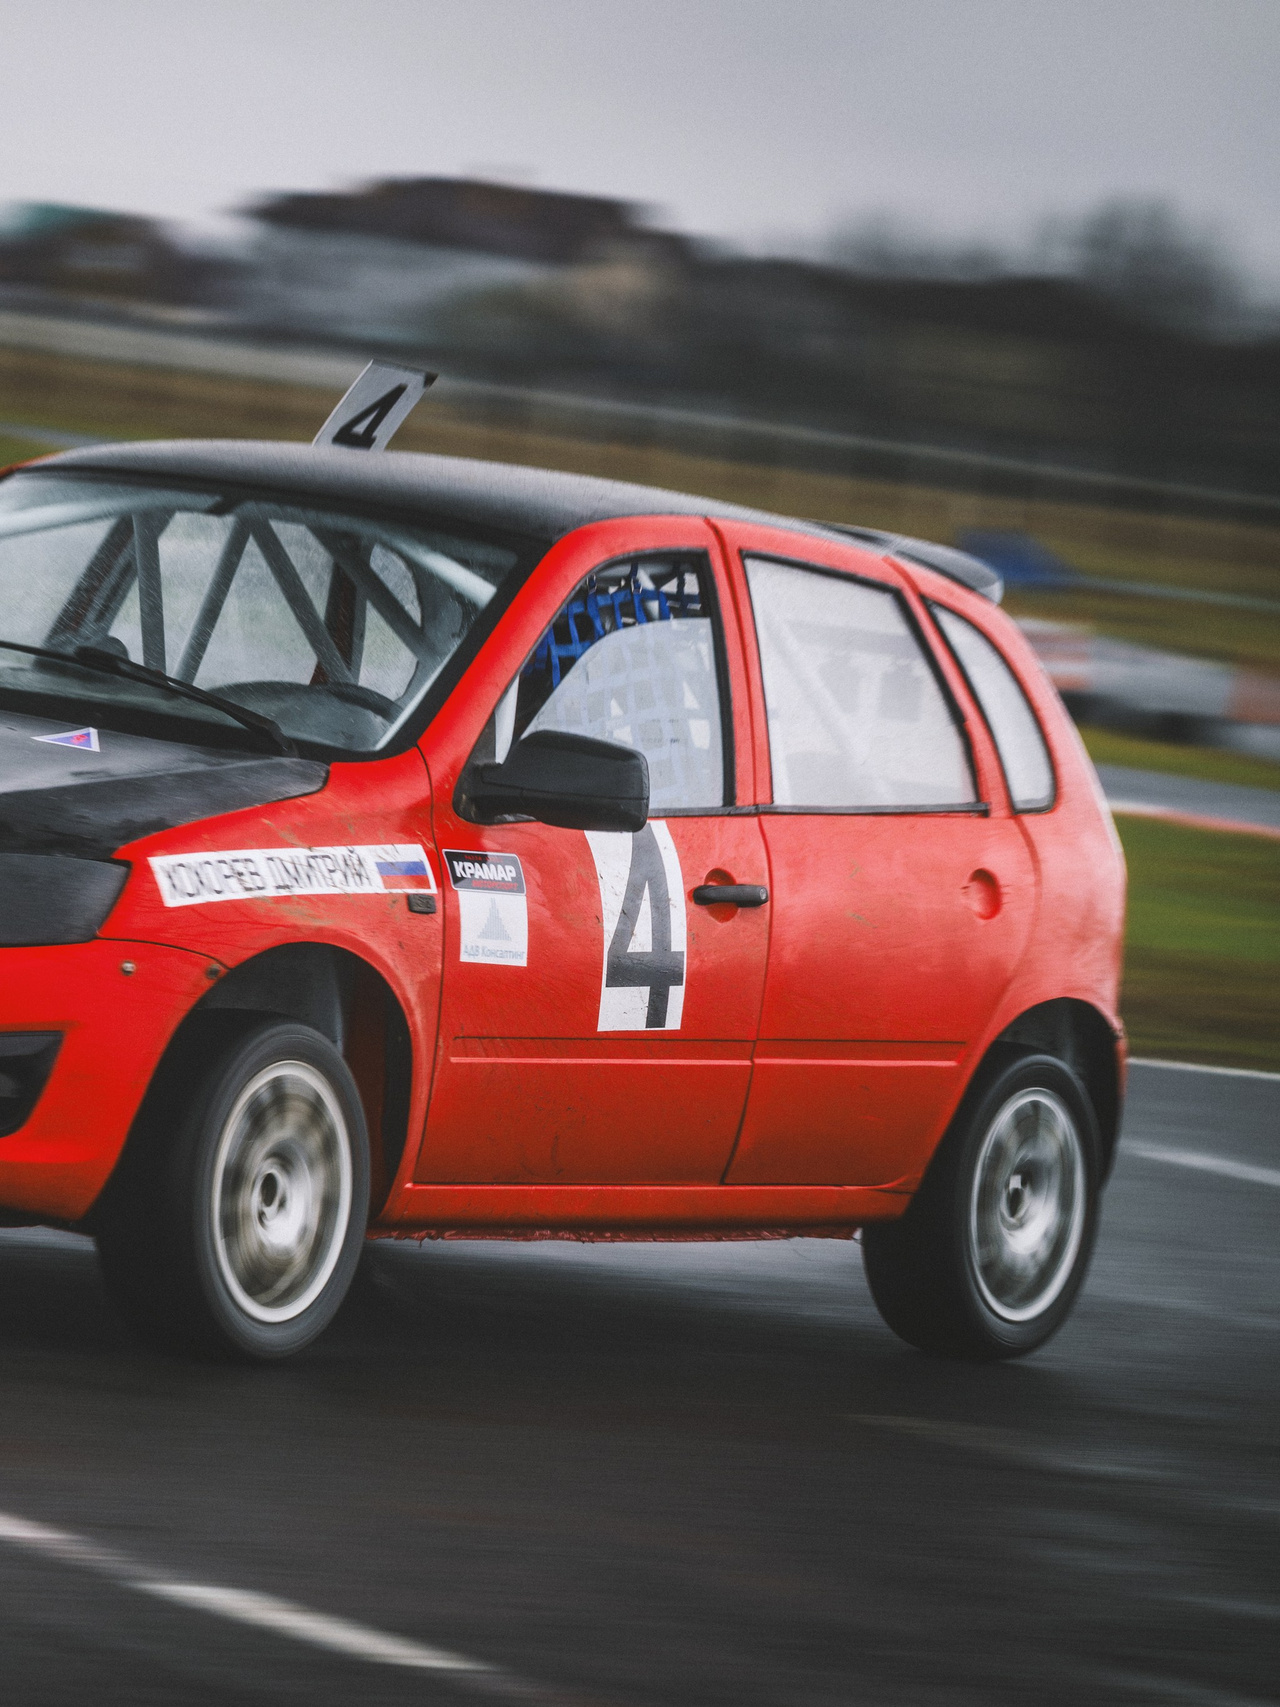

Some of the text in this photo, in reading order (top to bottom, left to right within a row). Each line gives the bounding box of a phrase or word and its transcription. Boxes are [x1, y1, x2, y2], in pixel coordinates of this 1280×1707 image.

[331, 382, 408, 451] 4
[266, 847, 372, 891] ДМИТРИЙ
[452, 861, 517, 882] КРАМАР
[605, 822, 685, 1029] 4
